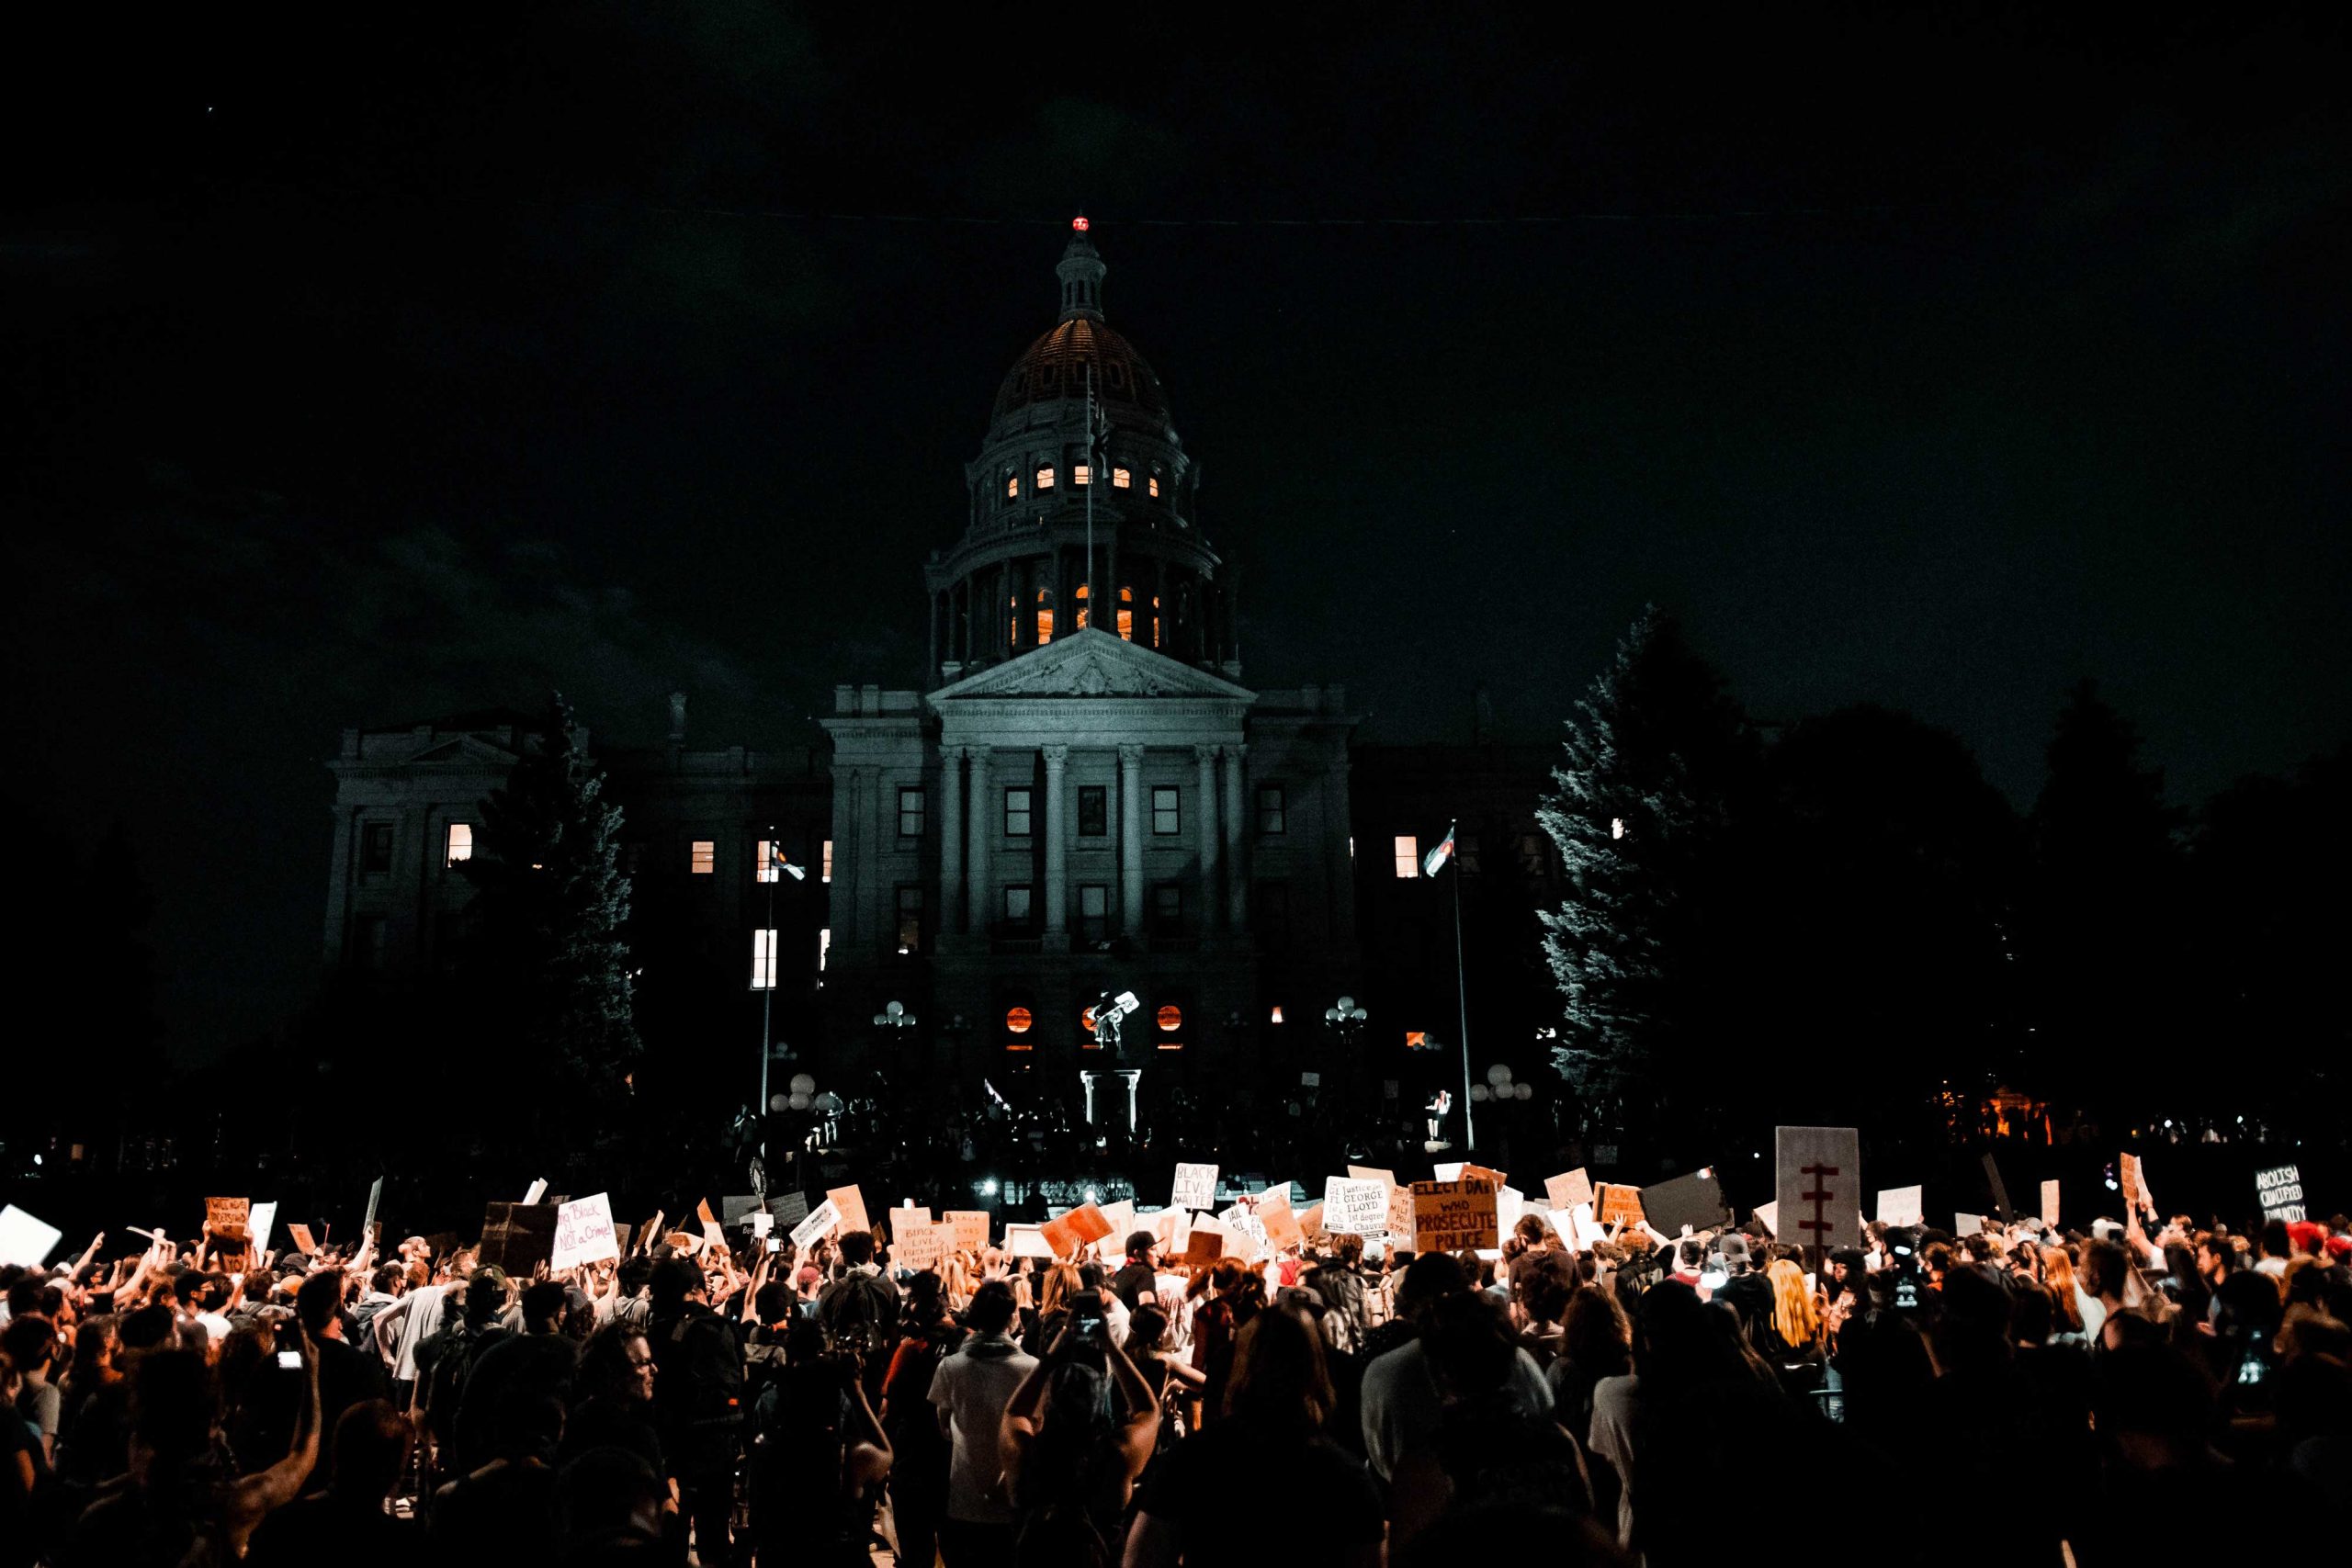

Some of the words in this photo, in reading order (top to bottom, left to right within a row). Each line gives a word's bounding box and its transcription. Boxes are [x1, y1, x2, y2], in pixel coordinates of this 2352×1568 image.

[1177, 1166, 1215, 1179] BLACK
[2256, 1164, 2300, 1190] ABOLISH
[1175, 1179, 1214, 1195] LIVES
[1342, 1185, 1372, 1194] Justice
[1414, 1181, 1458, 1194] ELECT
[1172, 1195, 1213, 1207] MATTER
[1343, 1190, 1383, 1203] GEORGE
[569, 1202, 601, 1221] Black
[1347, 1201, 1379, 1213] FLOYD
[1441, 1200, 1470, 1212] WHO
[1416, 1213, 1497, 1233] PROSECUTE
[1435, 1231, 1485, 1250] POLICE
